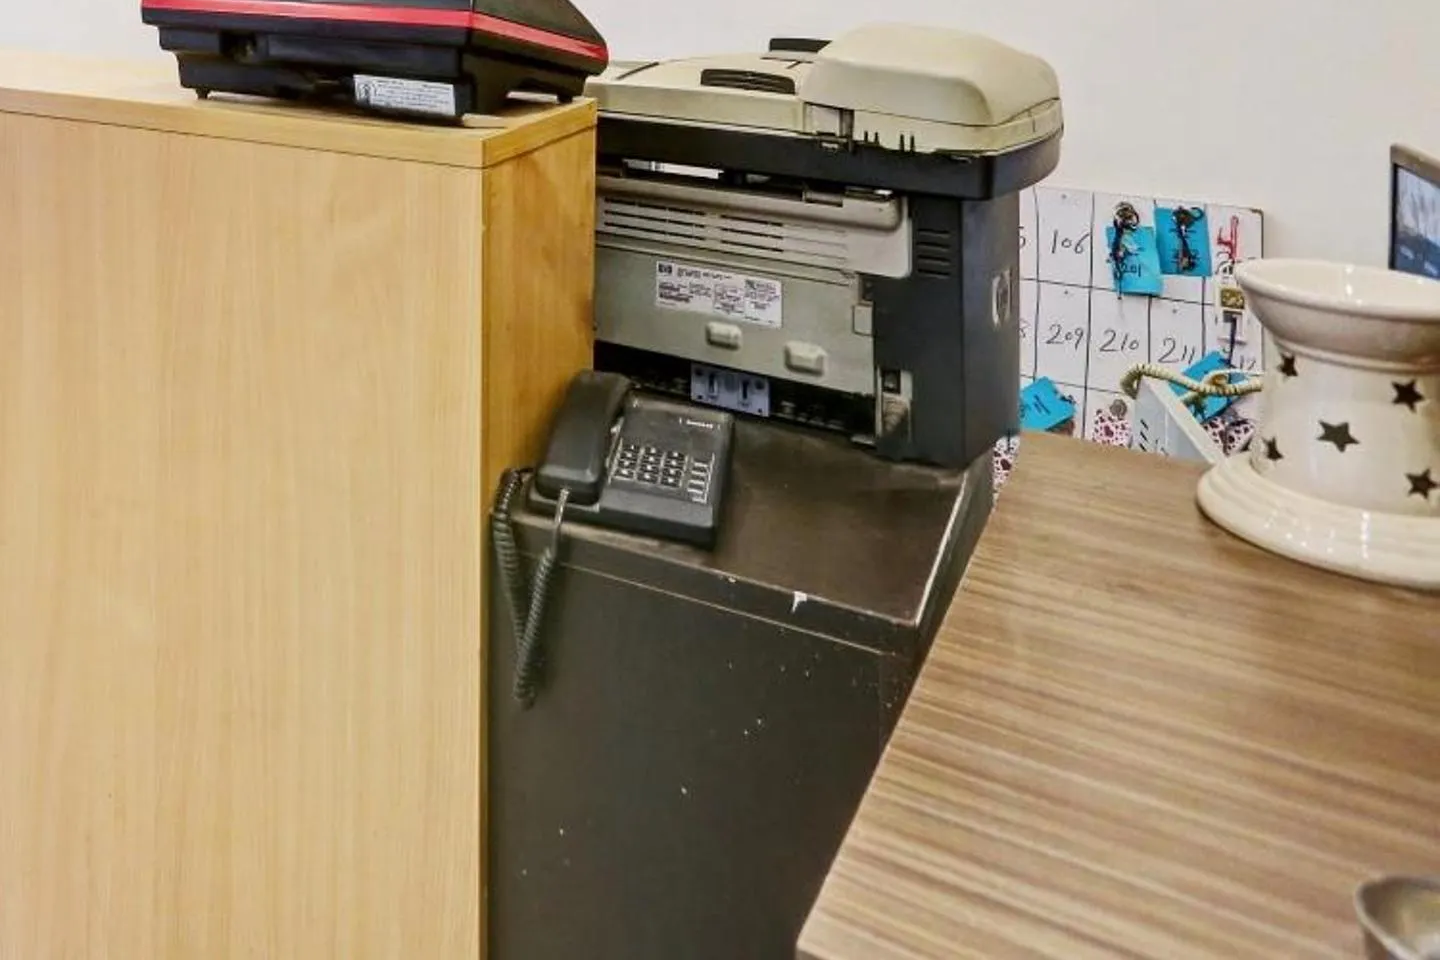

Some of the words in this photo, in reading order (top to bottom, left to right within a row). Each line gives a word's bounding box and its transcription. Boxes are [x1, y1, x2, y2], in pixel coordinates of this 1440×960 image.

[1051, 229, 1090, 254] 106
[1046, 323, 1084, 350] 209
[1099, 329, 1140, 353] 210
[1157, 337, 1196, 365] 211
